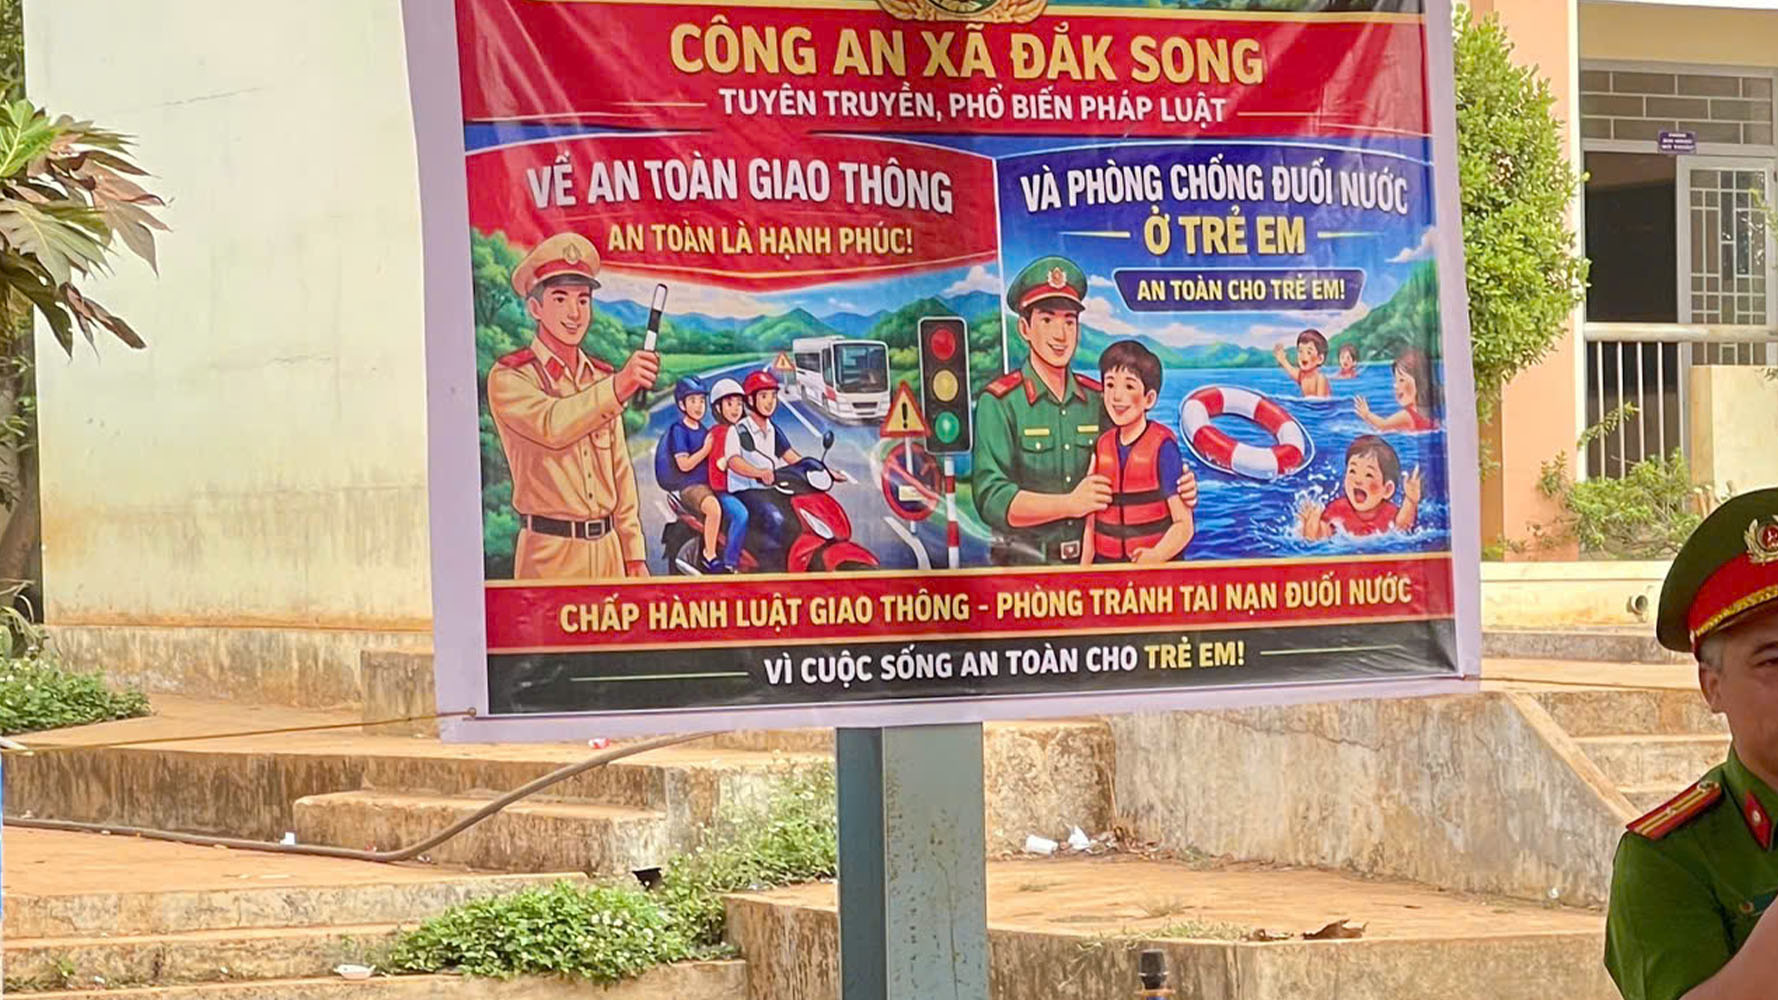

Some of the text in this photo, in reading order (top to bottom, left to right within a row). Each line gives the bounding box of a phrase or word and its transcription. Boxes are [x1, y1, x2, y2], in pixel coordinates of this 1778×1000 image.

[669, 14, 817, 75] CÔNG
[833, 28, 906, 77] AN
[921, 23, 996, 79] XÃ
[1130, 35, 1265, 84] SONG
[718, 81, 1227, 129] TUYÊN TRUYỀN, PHỔ BIẾN PHÁP LUẬT
[587, 160, 641, 204] AN
[644, 151, 738, 202] TOÀN
[748, 158, 831, 202] GIAO
[838, 157, 955, 215] THÔNG
[1020, 165, 1063, 213] VÀ
[1068, 158, 1164, 208] PHÒNG
[1171, 153, 1264, 202] CHỐNG
[1341, 167, 1409, 215] NƯỚC
[608, 220, 914, 260] AN TOÀN LÀ HẠNH PHÚC!
[1143, 204, 1306, 254] Ở TRẺ EM
[1136, 272, 1346, 301] AN TOÀN CHO TRẺ EM!
[560, 592, 640, 633] CHẤP
[648, 595, 728, 630] HÀNH
[736, 592, 802, 633] LUẬT
[809, 597, 873, 625] GIAO
[881, 589, 971, 622] THÔNG
[996, 585, 1084, 620] PHÒNG
[1088, 583, 1174, 615] TRÁNH
[1180, 584, 1219, 612] TAI
[1226, 582, 1278, 615] NẠN
[1284, 571, 1342, 609] ĐUỐI
[1348, 572, 1413, 605] NƯỚC
[764, 637, 1245, 688] VÌ CUỘC SỐNG AN TOÀN CHO TRẺ EM!
